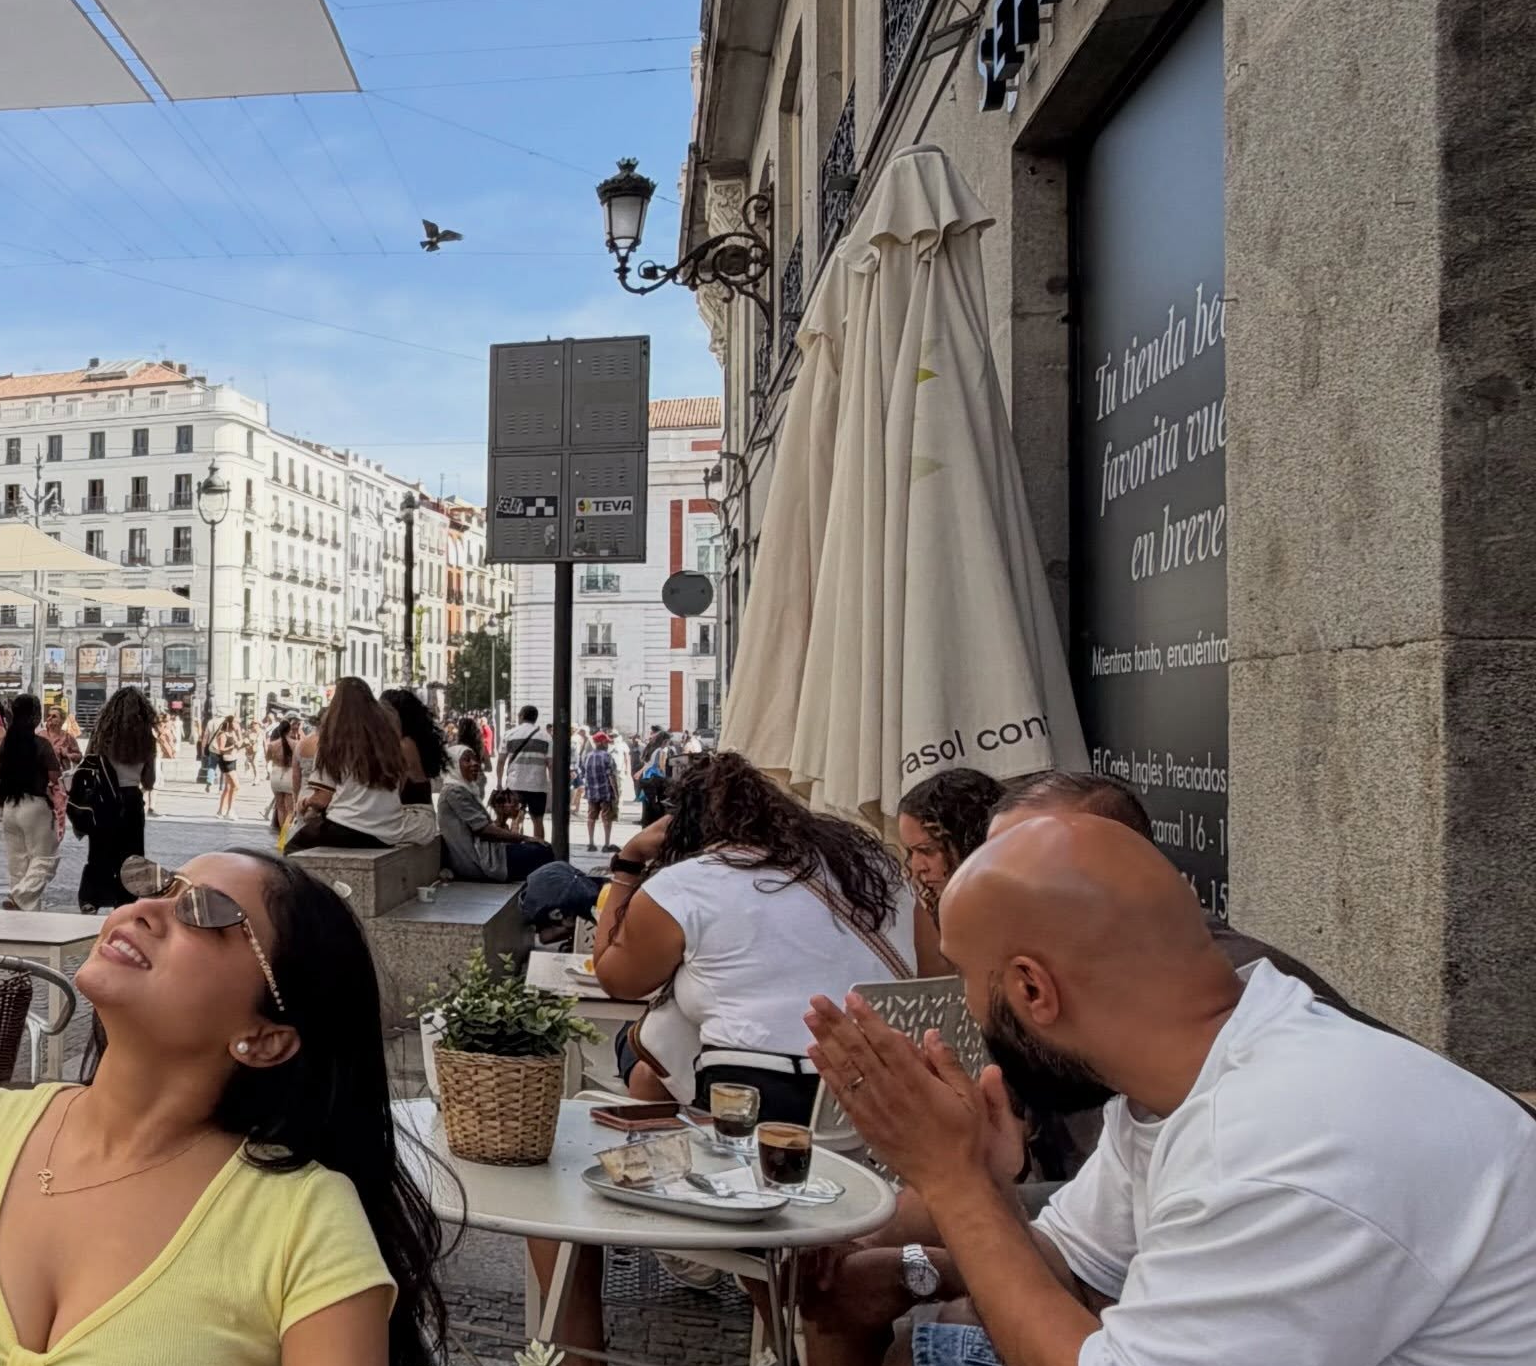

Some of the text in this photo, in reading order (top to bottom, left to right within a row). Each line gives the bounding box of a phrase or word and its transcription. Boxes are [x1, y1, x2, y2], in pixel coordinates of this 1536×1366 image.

[1095, 352, 1116, 421] Tu
[1122, 304, 1186, 404] tienda
[1100, 415, 1179, 517] favorita
[593, 500, 632, 512] TEVA
[1131, 504, 1225, 581] en breve
[1092, 630, 1228, 676] Mientras tanto, encuéntra
[977, 714, 1052, 751] con
[1132, 748, 1163, 795] Inglés
[1166, 752, 1227, 793] Preciados
[1188, 813, 1205, 852] 16
